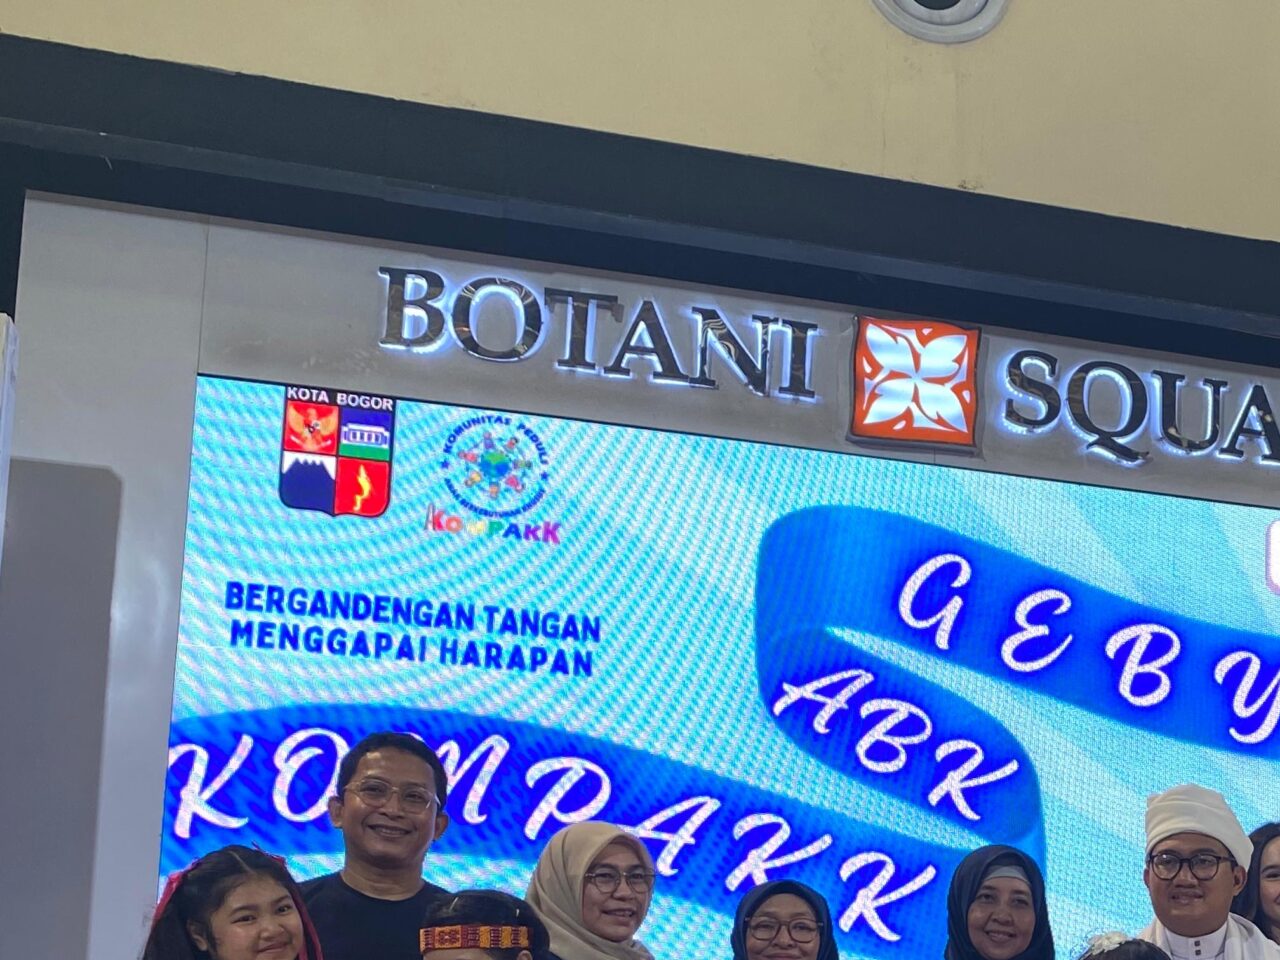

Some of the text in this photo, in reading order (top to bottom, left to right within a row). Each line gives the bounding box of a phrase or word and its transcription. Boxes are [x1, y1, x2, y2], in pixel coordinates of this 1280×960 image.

[378, 265, 818, 400] BOTANI
[287, 386, 393, 411] KOTA BOGOR
[443, 415, 549, 465] KOMUNITAS PEDULI
[225, 580, 601, 643] BERGANDENGAN TANGAN
[230, 618, 593, 677] MENGGAPAI HARAPAN
[772, 667, 1019, 822] ABK
